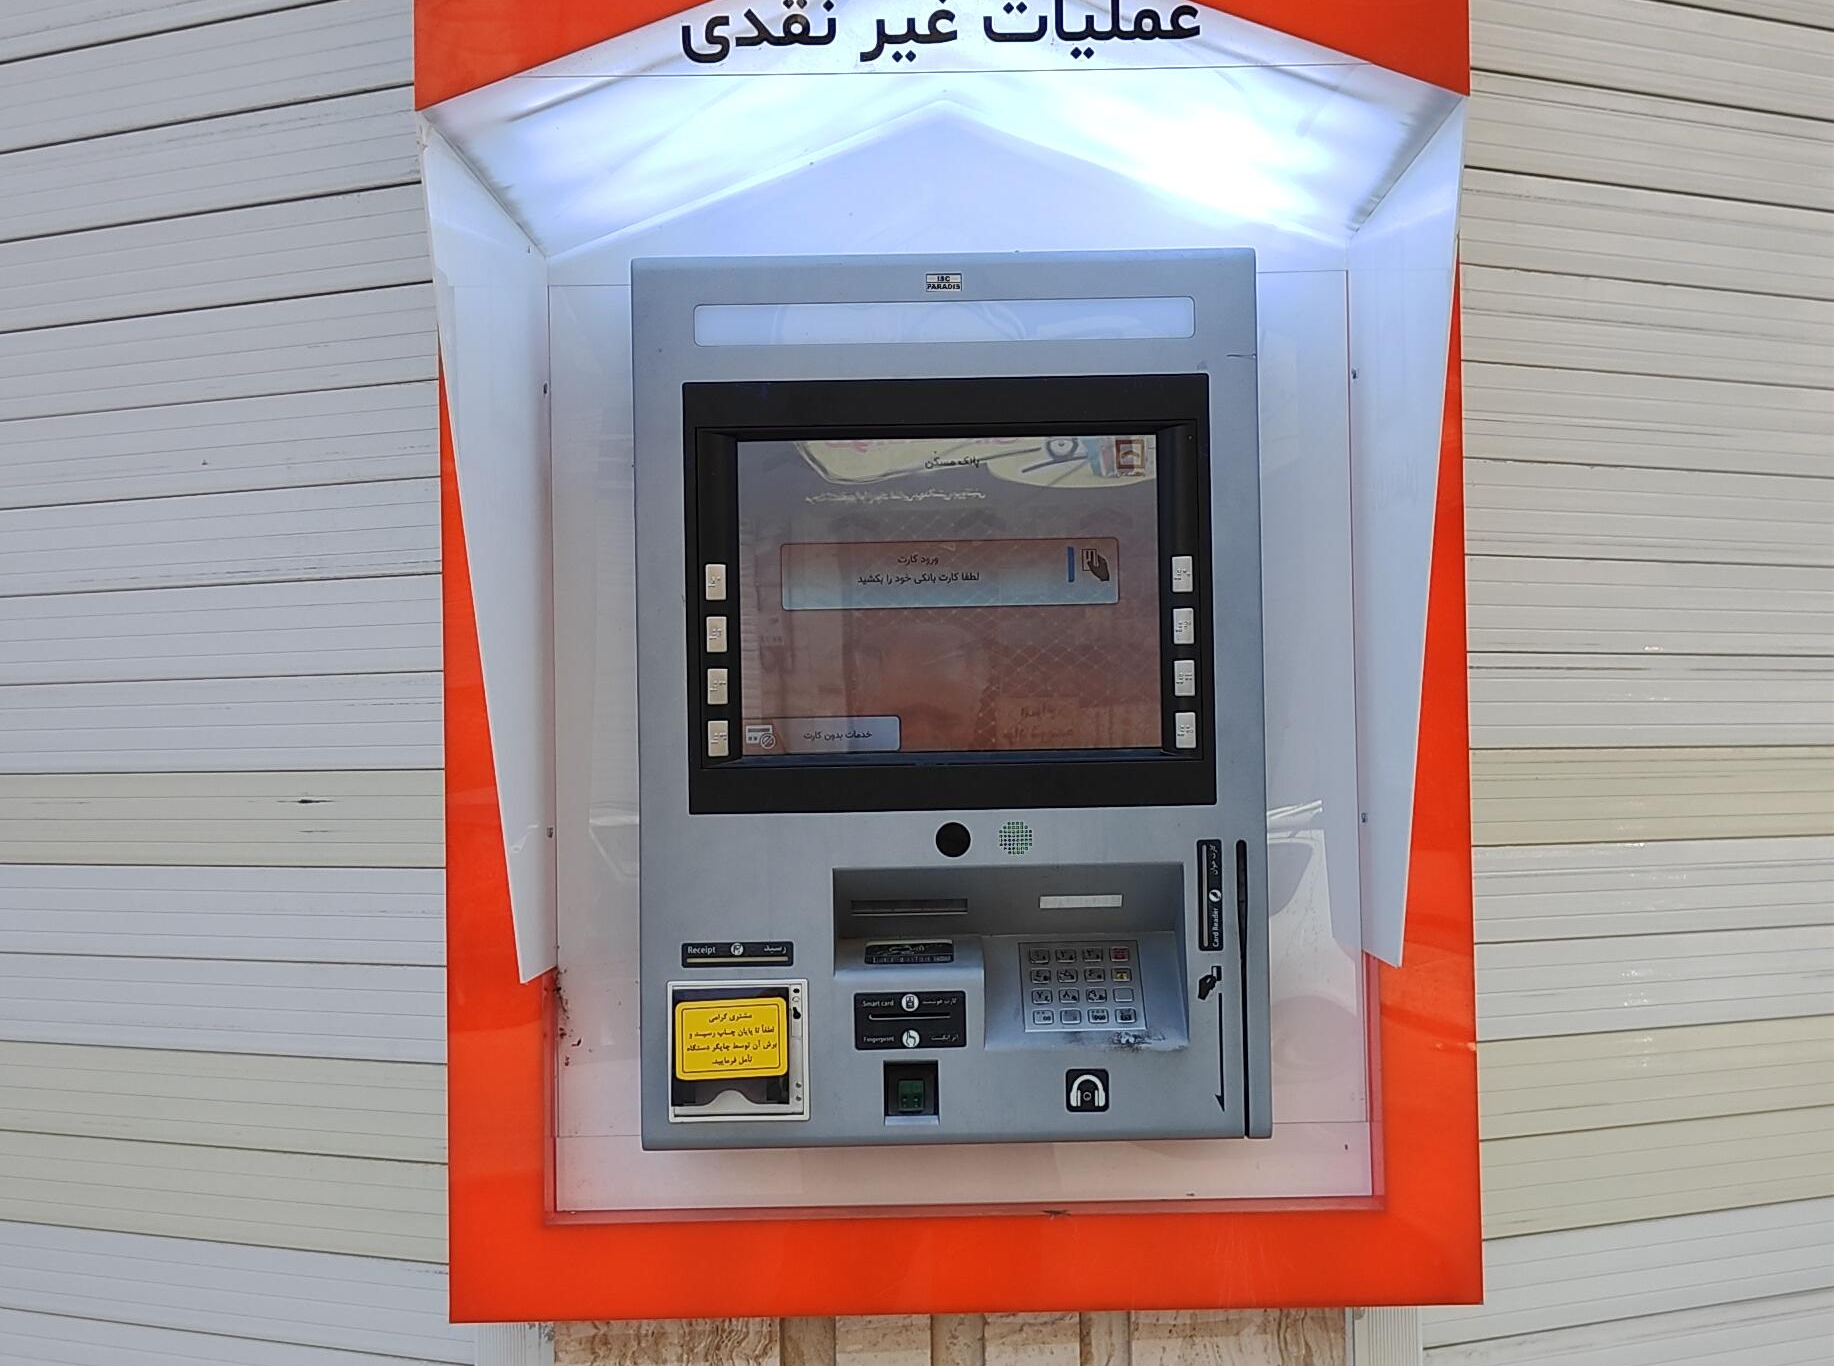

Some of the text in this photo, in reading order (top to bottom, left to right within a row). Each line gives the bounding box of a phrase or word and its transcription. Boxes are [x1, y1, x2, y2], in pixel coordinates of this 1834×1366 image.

[897, 554, 939, 566] ورود کارت
[857, 573, 884, 586] بکشید
[886, 574, 893, 584] را
[895, 573, 911, 584] خود
[914, 572, 936, 585] بانکی
[938, 572, 959, 584] کارت
[803, 730, 873, 742] خدمات بدون کارت
[1212, 931, 1220, 947] Card
[687, 946, 716, 955] Receipt
[764, 945, 787, 954] رسید
[862, 999, 894, 1008] Smart card
[709, 1012, 753, 1023] مشتری گرامی
[694, 1030, 716, 1038] رسید
[718, 1030, 736, 1038] چاپ
[738, 1026, 753, 1037] پایان
[687, 1043, 710, 1052] دستگاه
[733, 1042, 751, 1050] توسط
[752, 1040, 761, 1050] آن
[762, 1041, 778, 1050] برش
